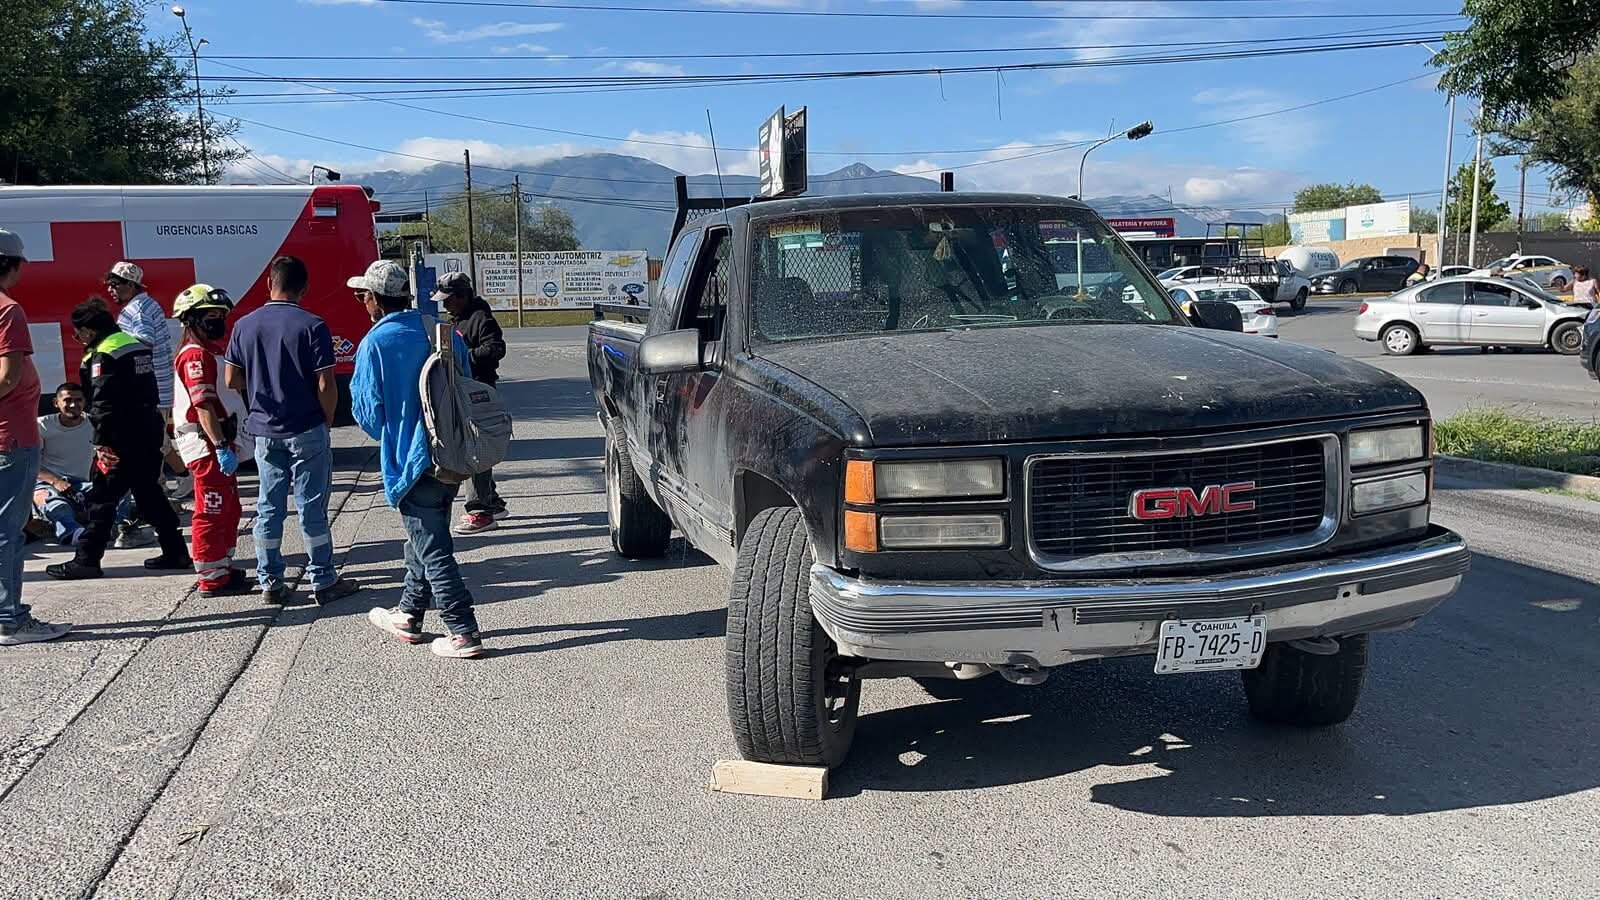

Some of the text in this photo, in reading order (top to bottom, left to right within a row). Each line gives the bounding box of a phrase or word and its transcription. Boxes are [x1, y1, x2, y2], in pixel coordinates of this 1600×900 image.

[156, 224, 258, 235] URGENCIAS BASICAS
[509, 252, 550, 260] MCANICO
[554, 251, 602, 260] AUTOMOTRIZ
[1129, 481, 1255, 520] GMC
[1162, 631, 1263, 660] FB-7425-D
